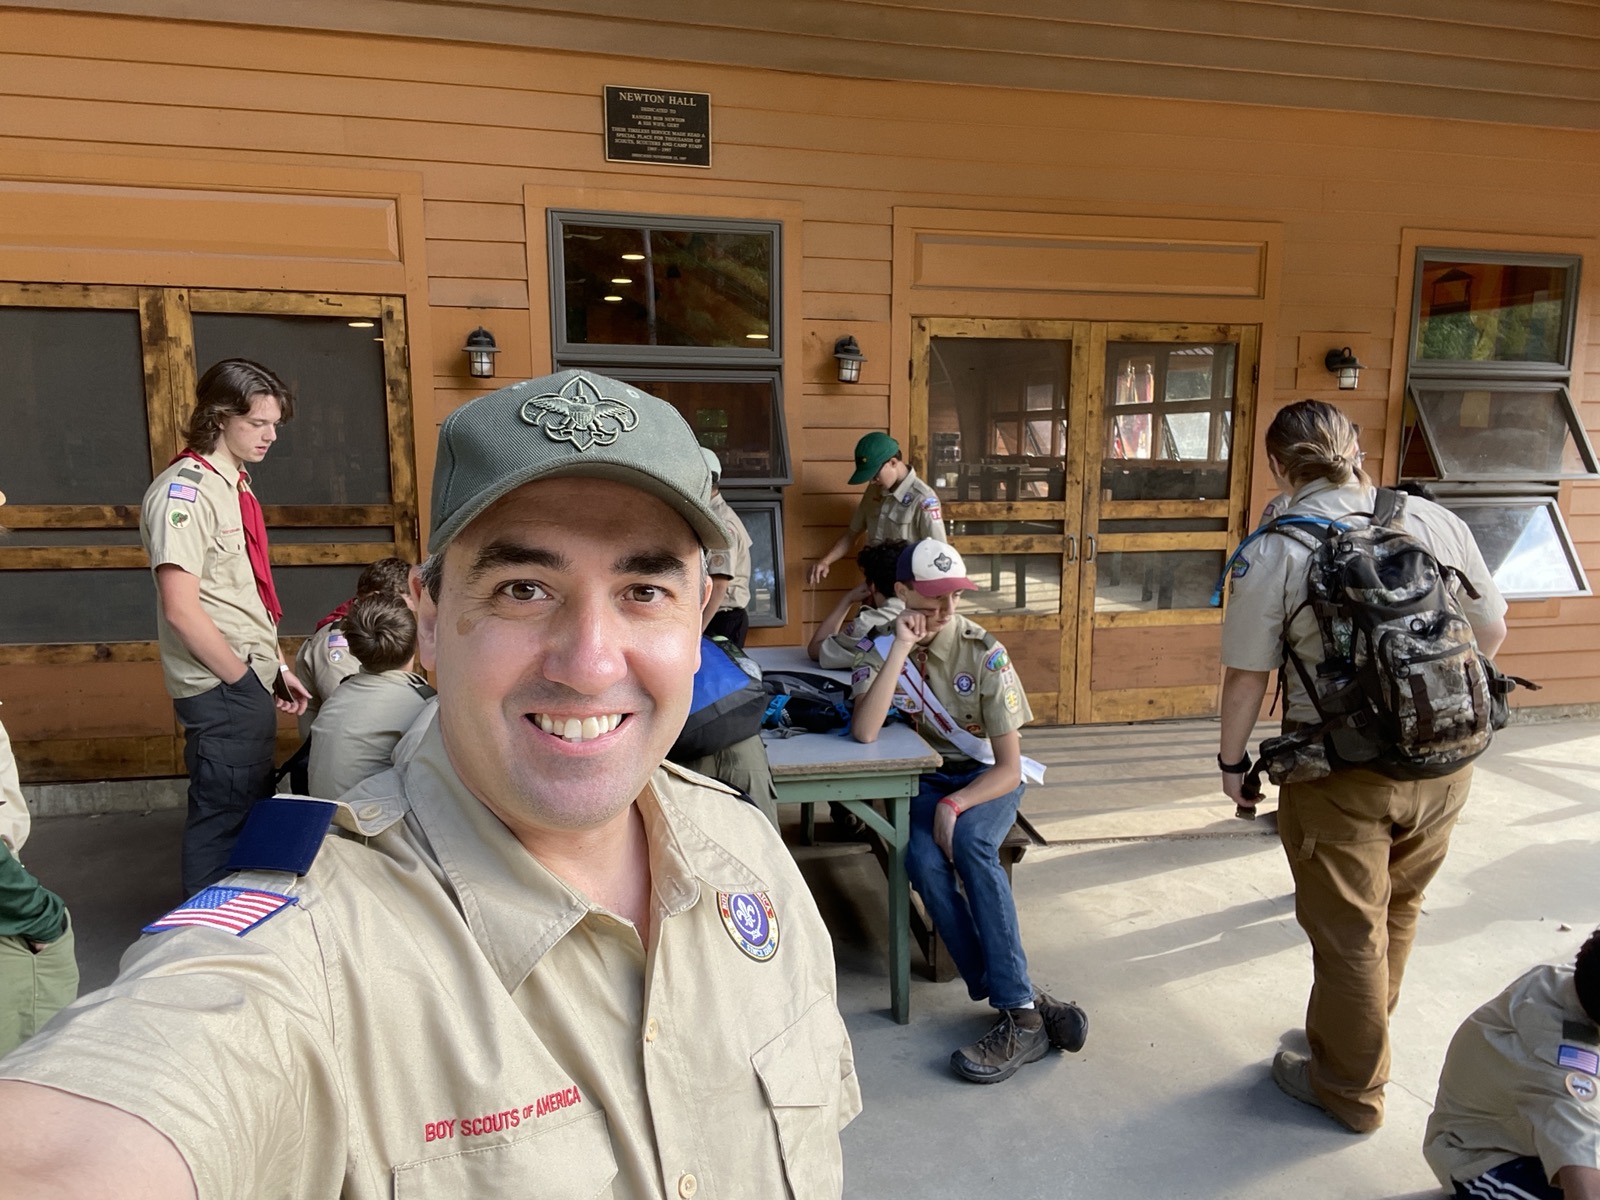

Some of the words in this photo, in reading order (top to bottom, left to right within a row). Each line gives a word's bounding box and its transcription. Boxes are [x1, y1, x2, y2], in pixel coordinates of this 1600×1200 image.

[619, 92, 664, 103] NEWTON
[669, 96, 696, 106] HALL
[425, 1119, 456, 1142] BOY
[461, 1109, 520, 1136] SCOUTS
[523, 1105, 533, 1119] OF
[536, 1085, 581, 1118] AMERICA
